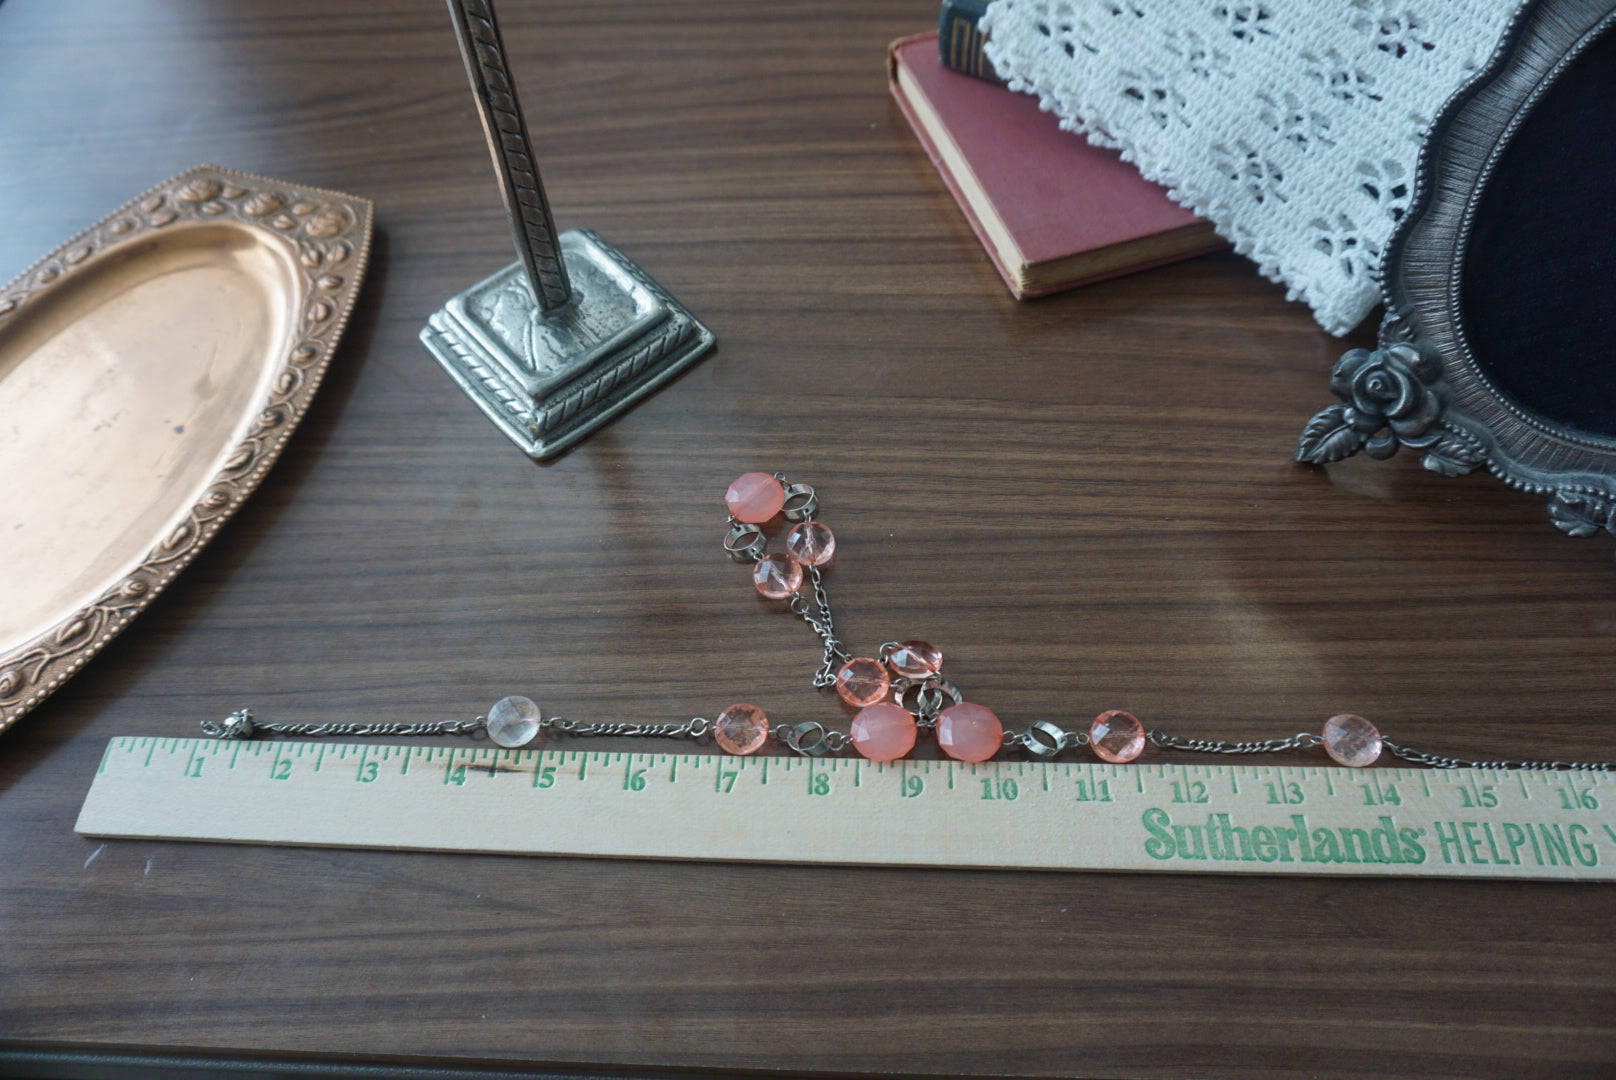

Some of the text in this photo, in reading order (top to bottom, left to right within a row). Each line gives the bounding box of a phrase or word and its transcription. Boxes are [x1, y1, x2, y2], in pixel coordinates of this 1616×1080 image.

[190, 757, 1600, 810] 1 2 3 4 5 6 7 8 9 10 11 12 13 14 15 16
[1434, 821, 1598, 867] HELPING
